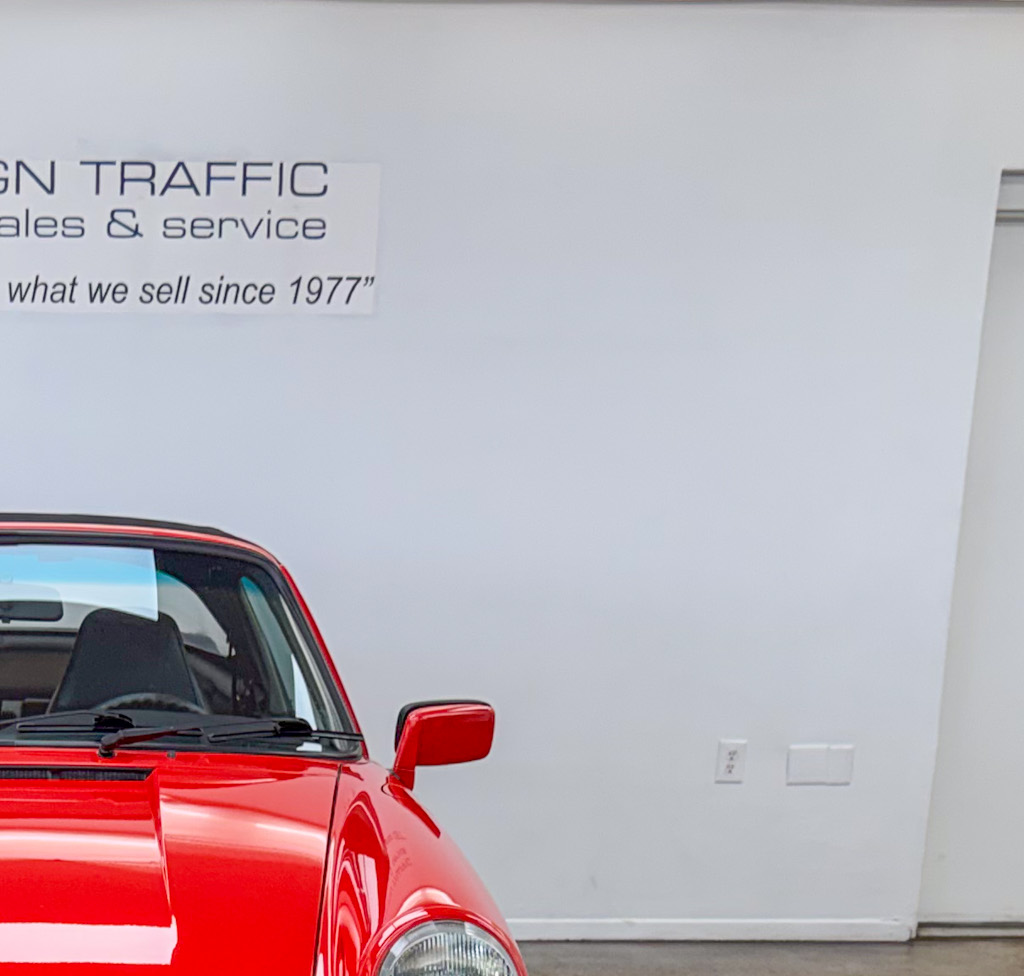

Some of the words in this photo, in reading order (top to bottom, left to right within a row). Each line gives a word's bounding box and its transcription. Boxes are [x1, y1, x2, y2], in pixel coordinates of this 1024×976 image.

[79, 160, 329, 198] TRAFFIC
[106, 208, 144, 240] &
[162, 209, 328, 241] service
[8, 274, 80, 305] what
[88, 282, 129, 305] we
[138, 275, 192, 305] sell
[198, 275, 276, 305] since
[290, 275, 375, 306] 1977”
